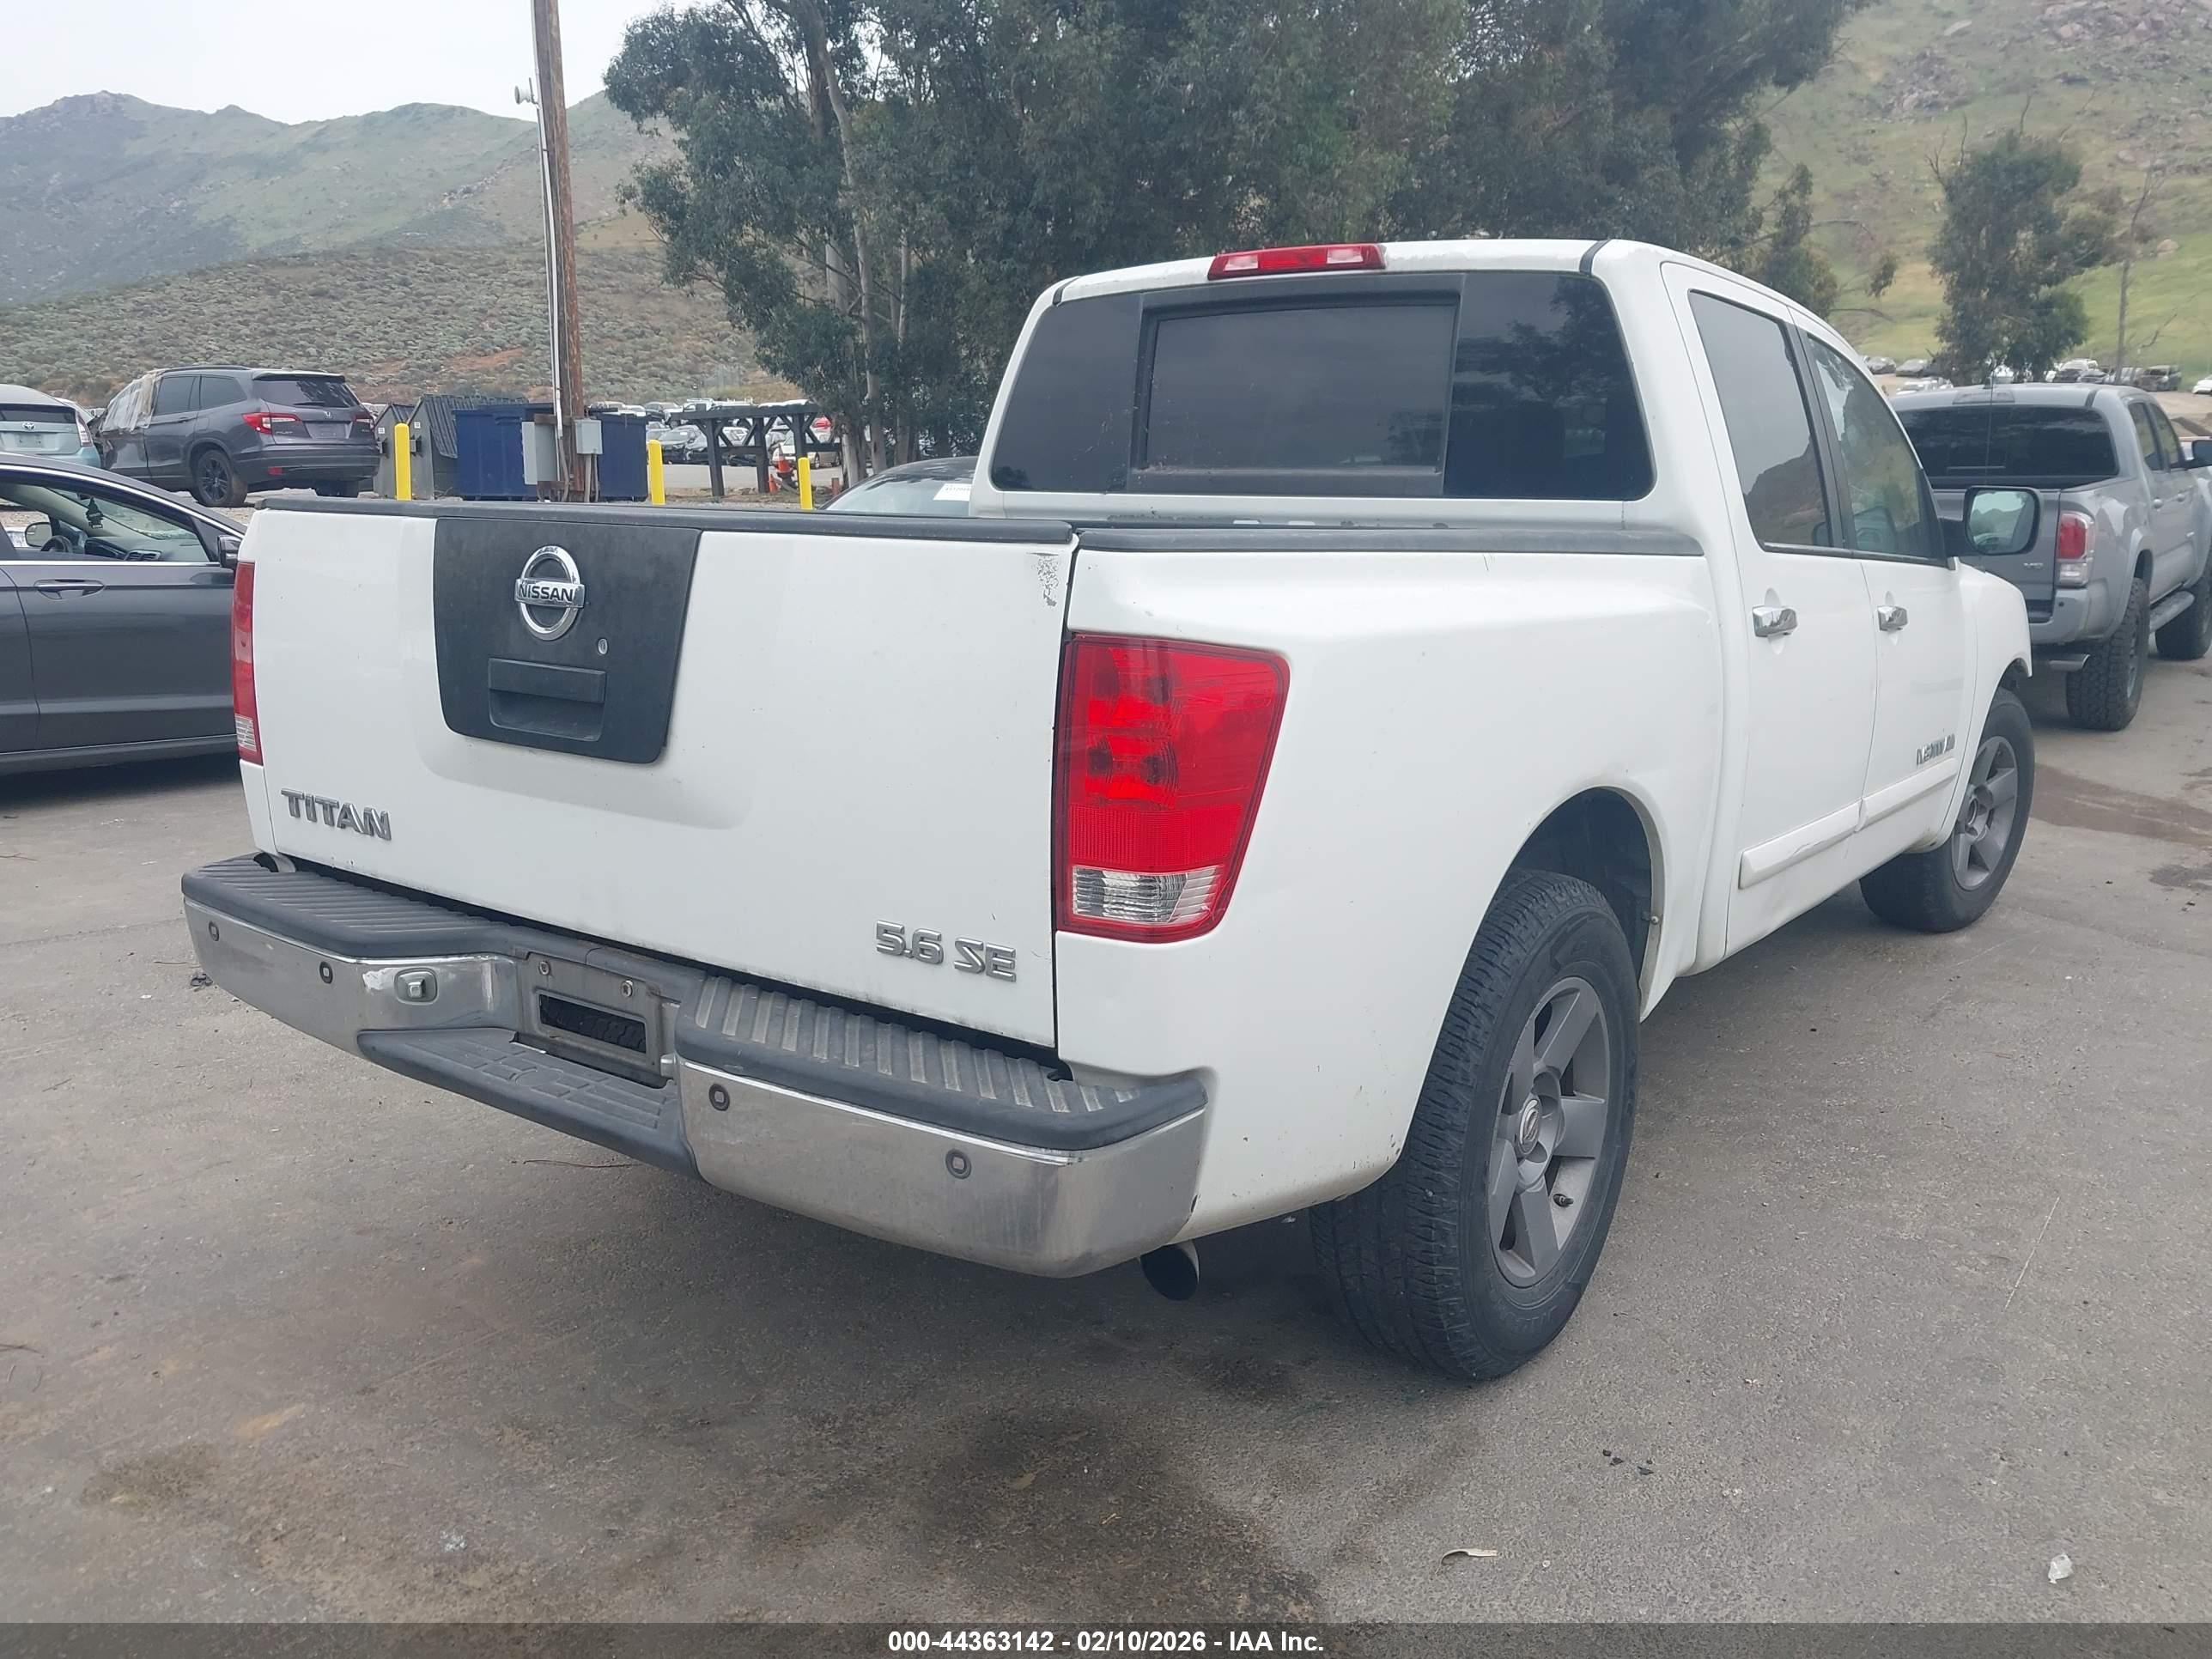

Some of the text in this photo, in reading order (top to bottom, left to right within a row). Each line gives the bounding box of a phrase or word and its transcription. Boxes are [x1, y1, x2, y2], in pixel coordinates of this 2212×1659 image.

[518, 585, 573, 602] NISSAN
[280, 787, 392, 841] TITAN
[876, 920, 1017, 982] 5.6 SE
